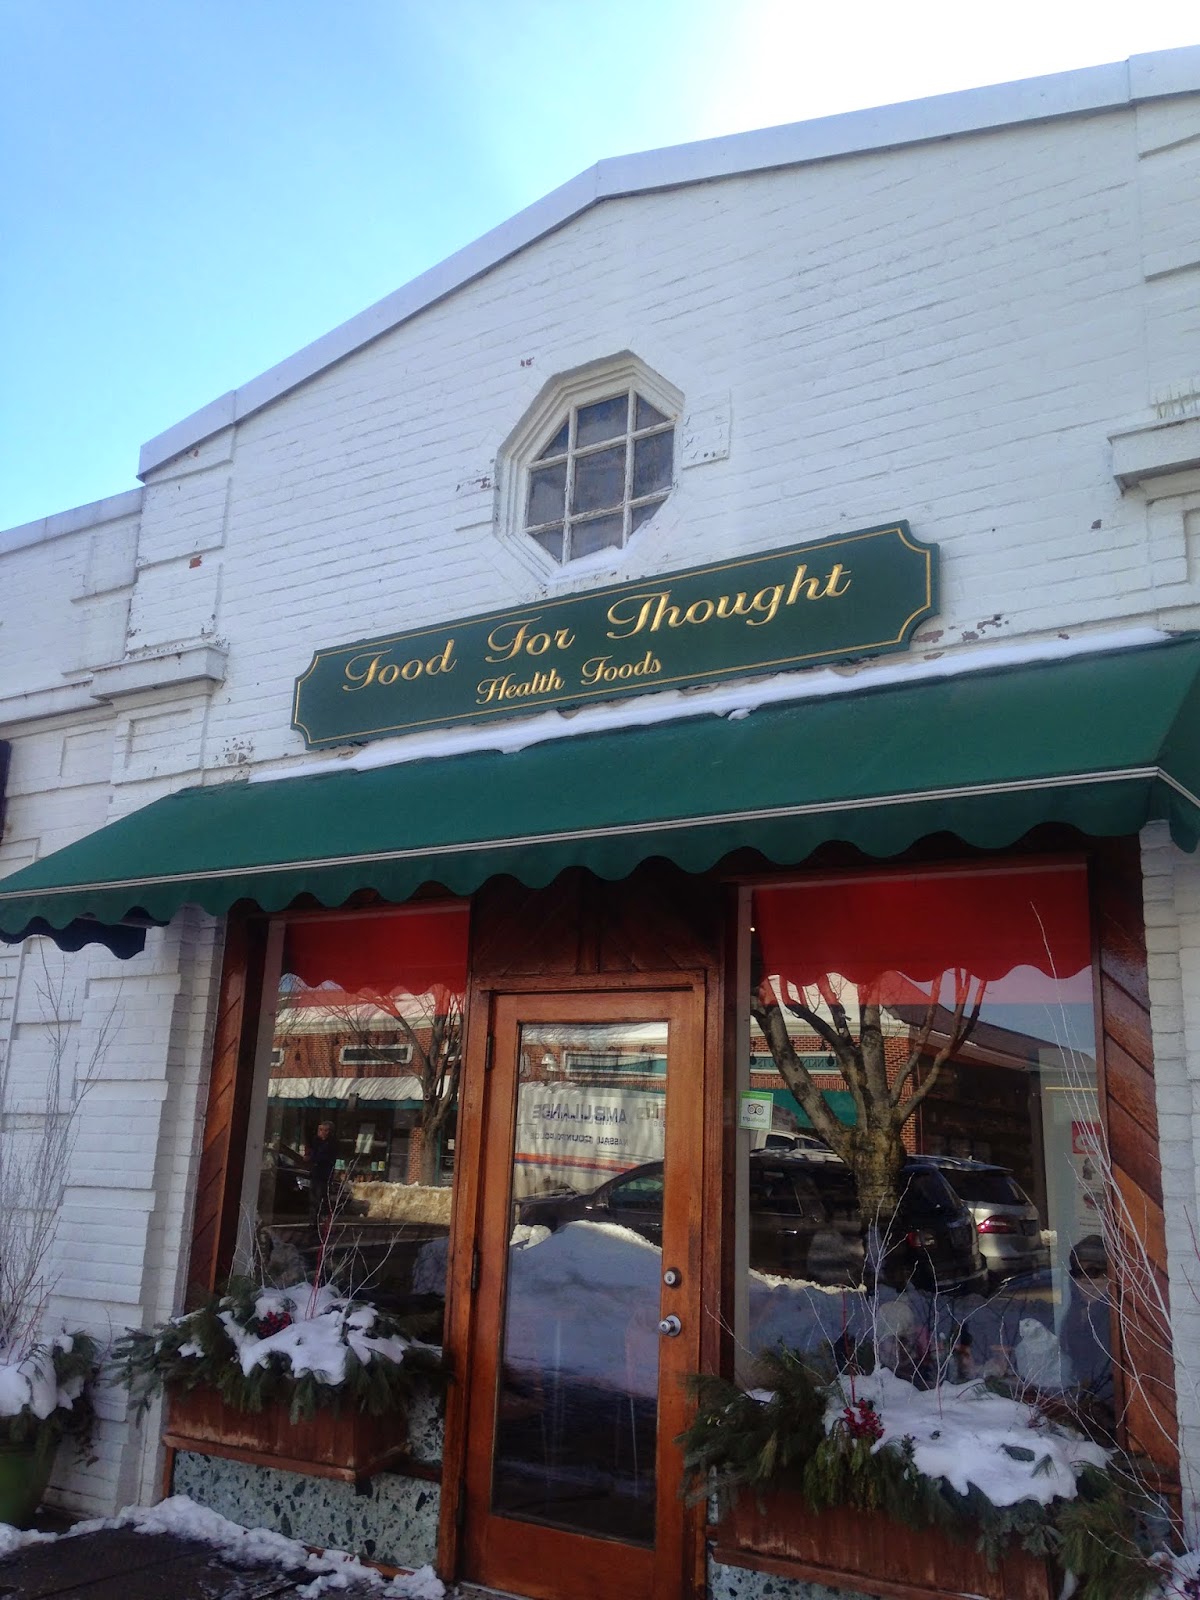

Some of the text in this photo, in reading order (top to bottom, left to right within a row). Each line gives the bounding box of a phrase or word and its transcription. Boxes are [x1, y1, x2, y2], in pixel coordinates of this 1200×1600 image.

[342, 562, 852, 692] Food For Thought
[475, 650, 662, 705] Health Foods
